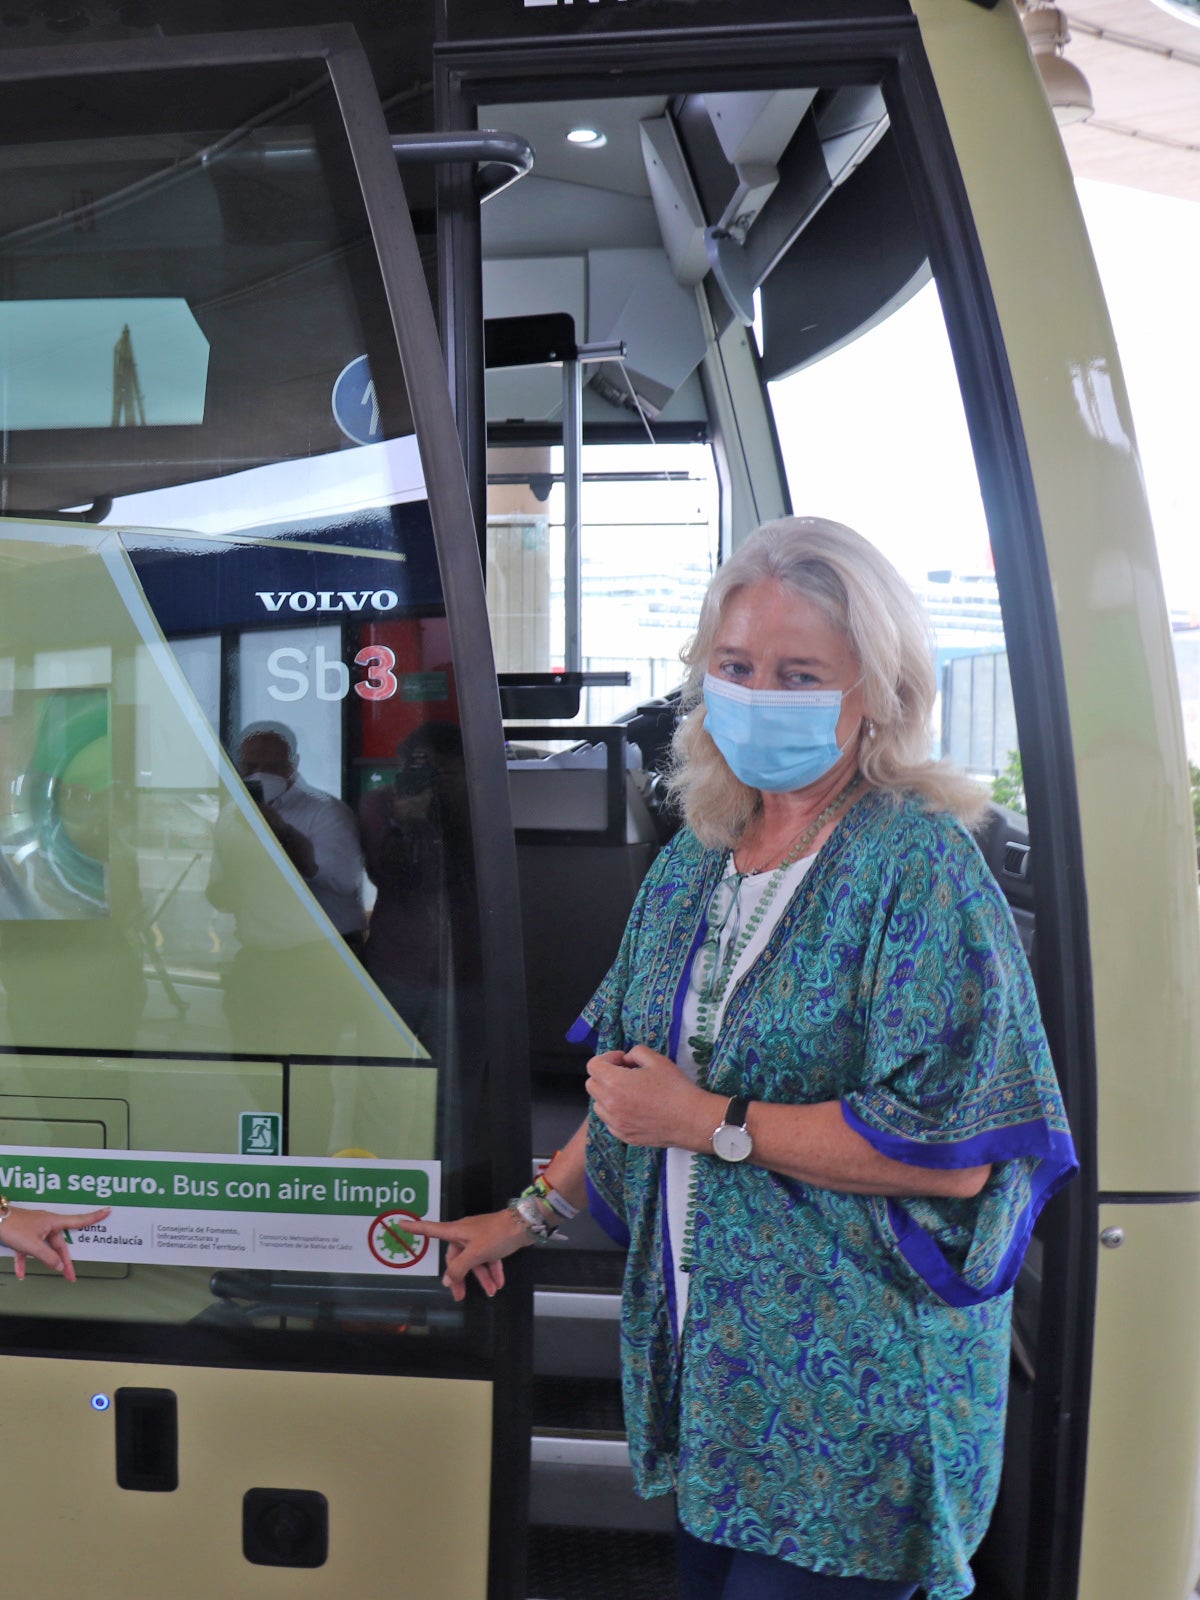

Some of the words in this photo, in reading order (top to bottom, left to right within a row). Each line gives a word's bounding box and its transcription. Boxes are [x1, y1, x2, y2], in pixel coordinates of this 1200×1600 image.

[255, 590, 399, 612] VOLVO
[267, 645, 398, 701] Sb3
[67, 1173, 165, 1198] seguro.
[173, 1174, 219, 1197] Bus
[225, 1180, 271, 1199] con
[278, 1178, 327, 1201] aire
[334, 1178, 416, 1208] limpio
[157, 1224, 194, 1233] Consejería
[78, 1234, 91, 1243] de
[93, 1235, 143, 1246] Andalucía
[157, 1232, 214, 1241] Infraestructuras
[157, 1240, 198, 1249] Ordenación
[199, 1242, 211, 1250] del
[212, 1243, 246, 1251] Territorio
